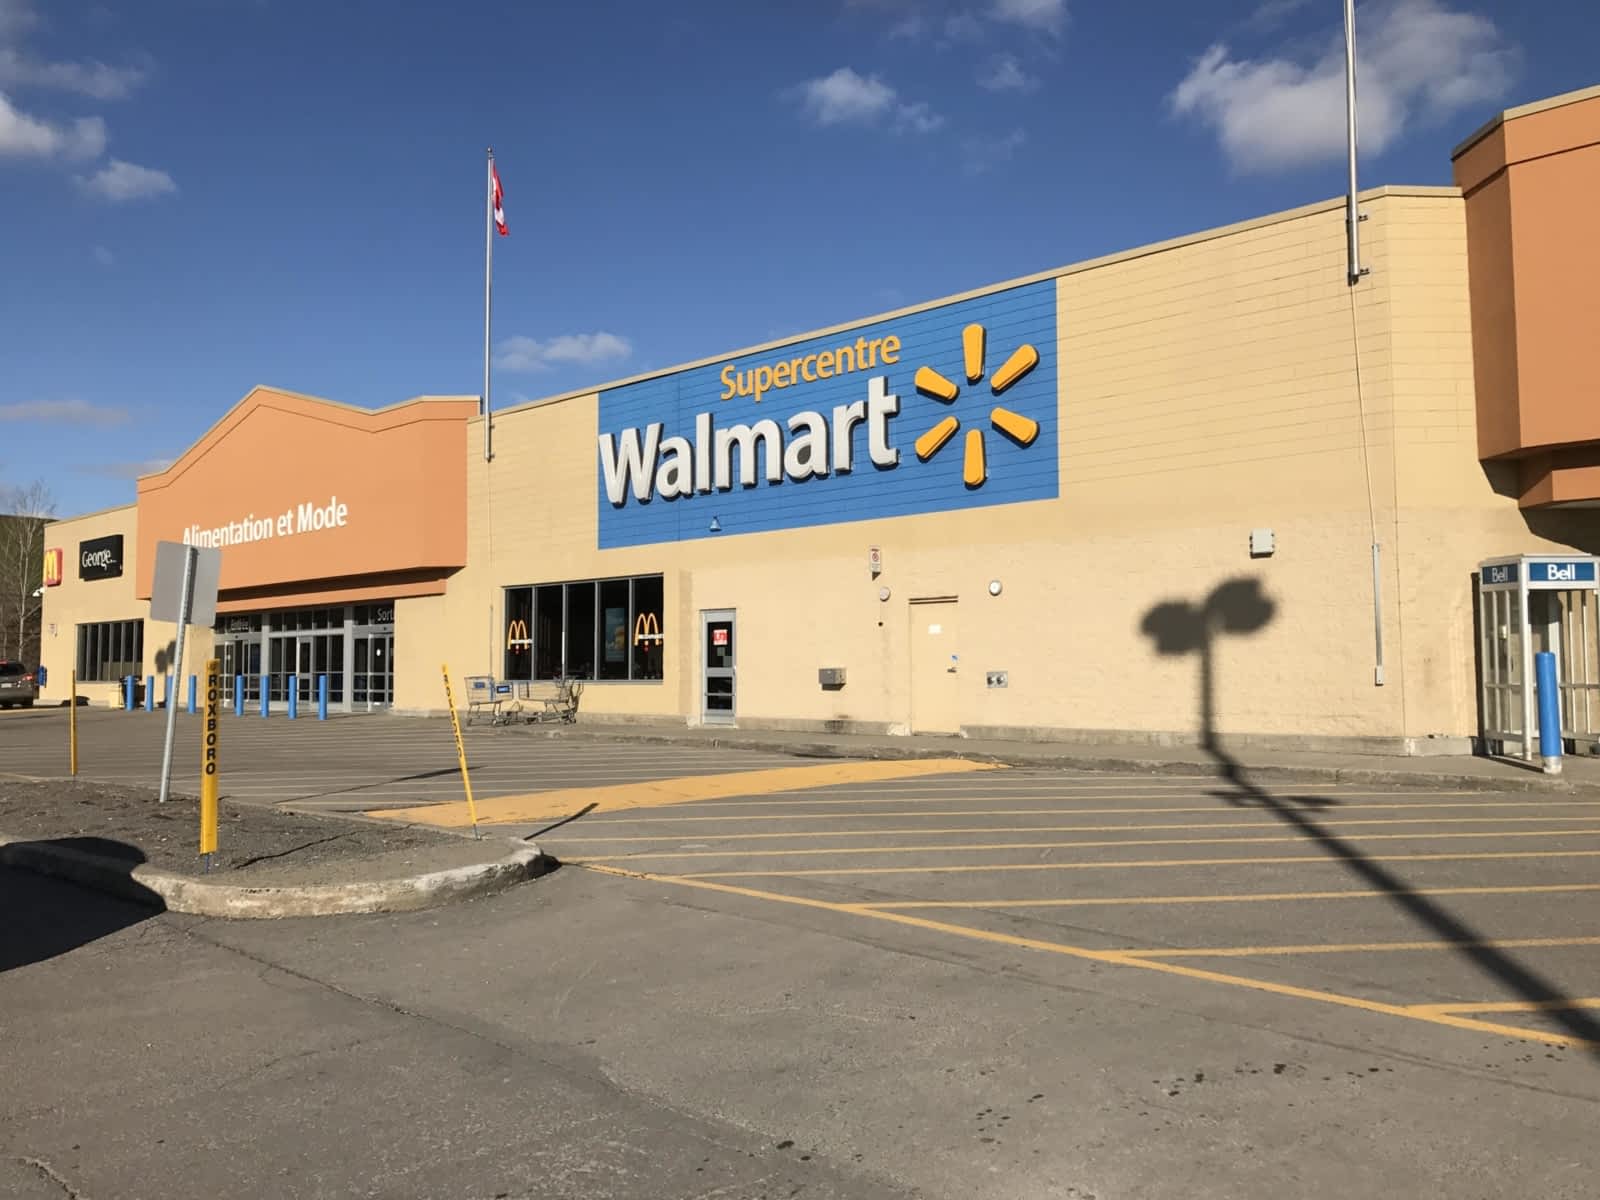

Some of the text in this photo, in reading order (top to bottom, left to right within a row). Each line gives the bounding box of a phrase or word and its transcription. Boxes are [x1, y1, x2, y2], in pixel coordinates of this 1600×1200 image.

[719, 335, 901, 402] Supercentre
[598, 376, 900, 506] Walmart
[183, 495, 348, 549] Alimentation et Mode
[1491, 566, 1509, 583] Bell
[1547, 564, 1576, 581] Bell
[206, 674, 218, 775] ROXBORO
